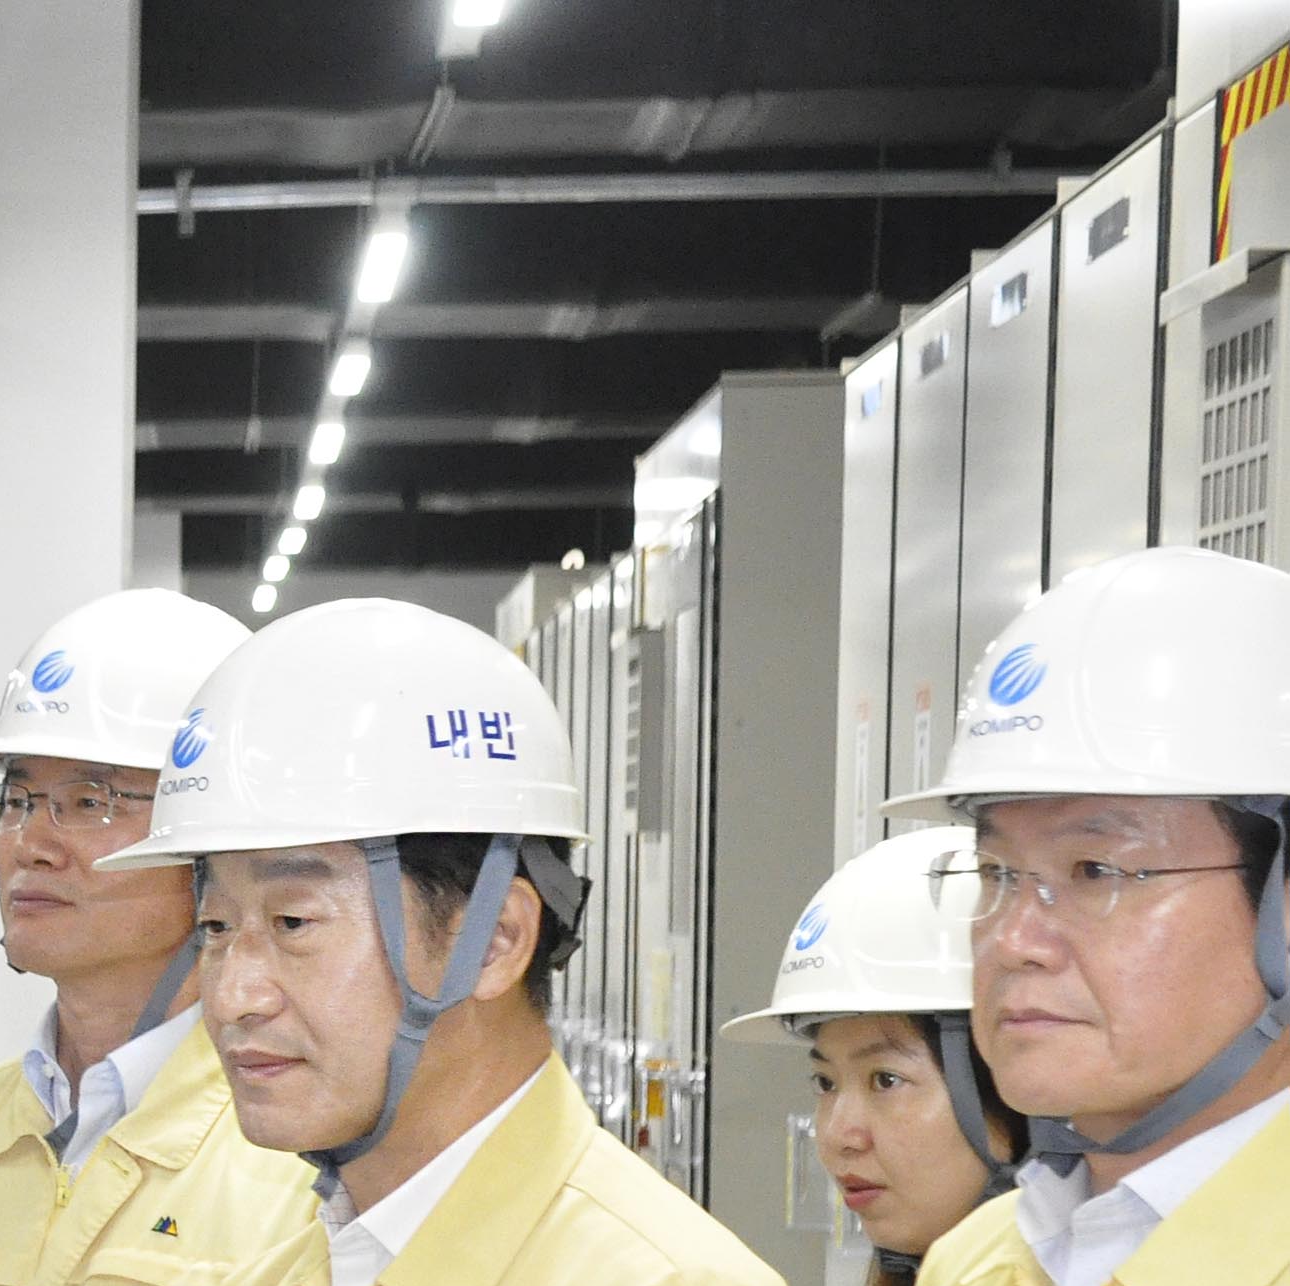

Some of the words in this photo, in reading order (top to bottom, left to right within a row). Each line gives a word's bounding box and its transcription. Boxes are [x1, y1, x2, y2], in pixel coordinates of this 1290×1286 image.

[425, 708, 517, 761] 내빈
[969, 715, 1044, 737] KOMIPO
[160, 776, 210, 796] OMIPO
[781, 956, 825, 975] OMIPO
